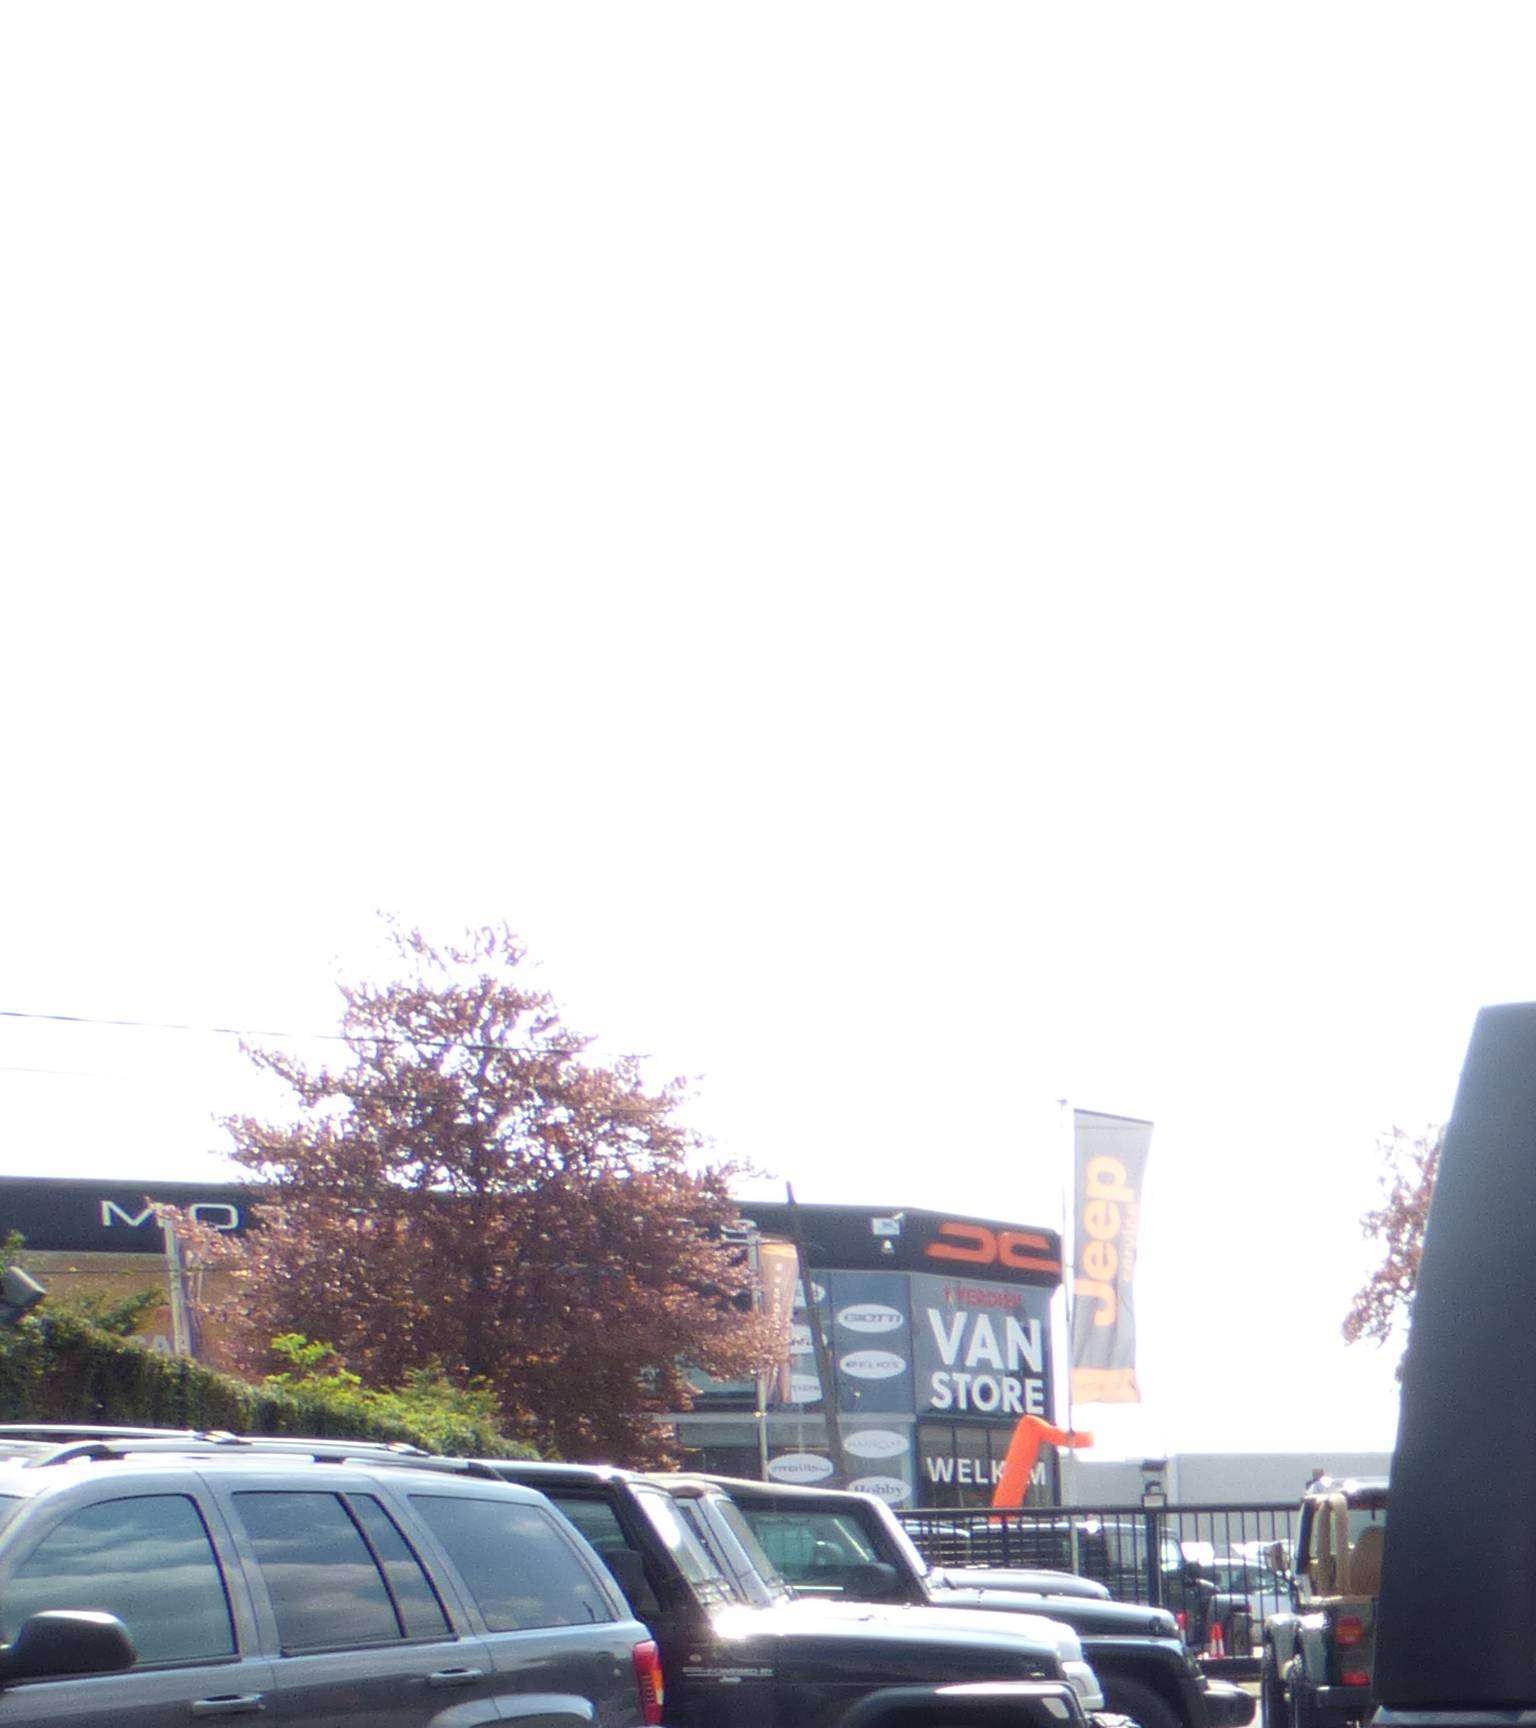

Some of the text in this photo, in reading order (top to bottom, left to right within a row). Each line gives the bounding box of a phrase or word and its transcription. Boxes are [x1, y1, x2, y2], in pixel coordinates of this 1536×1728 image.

[1074, 1154, 1135, 1327] Jeep
[927, 1307, 1043, 1373] VAN
[929, 1370, 1045, 1416] STORE
[926, 1456, 1046, 1486] WELKM
